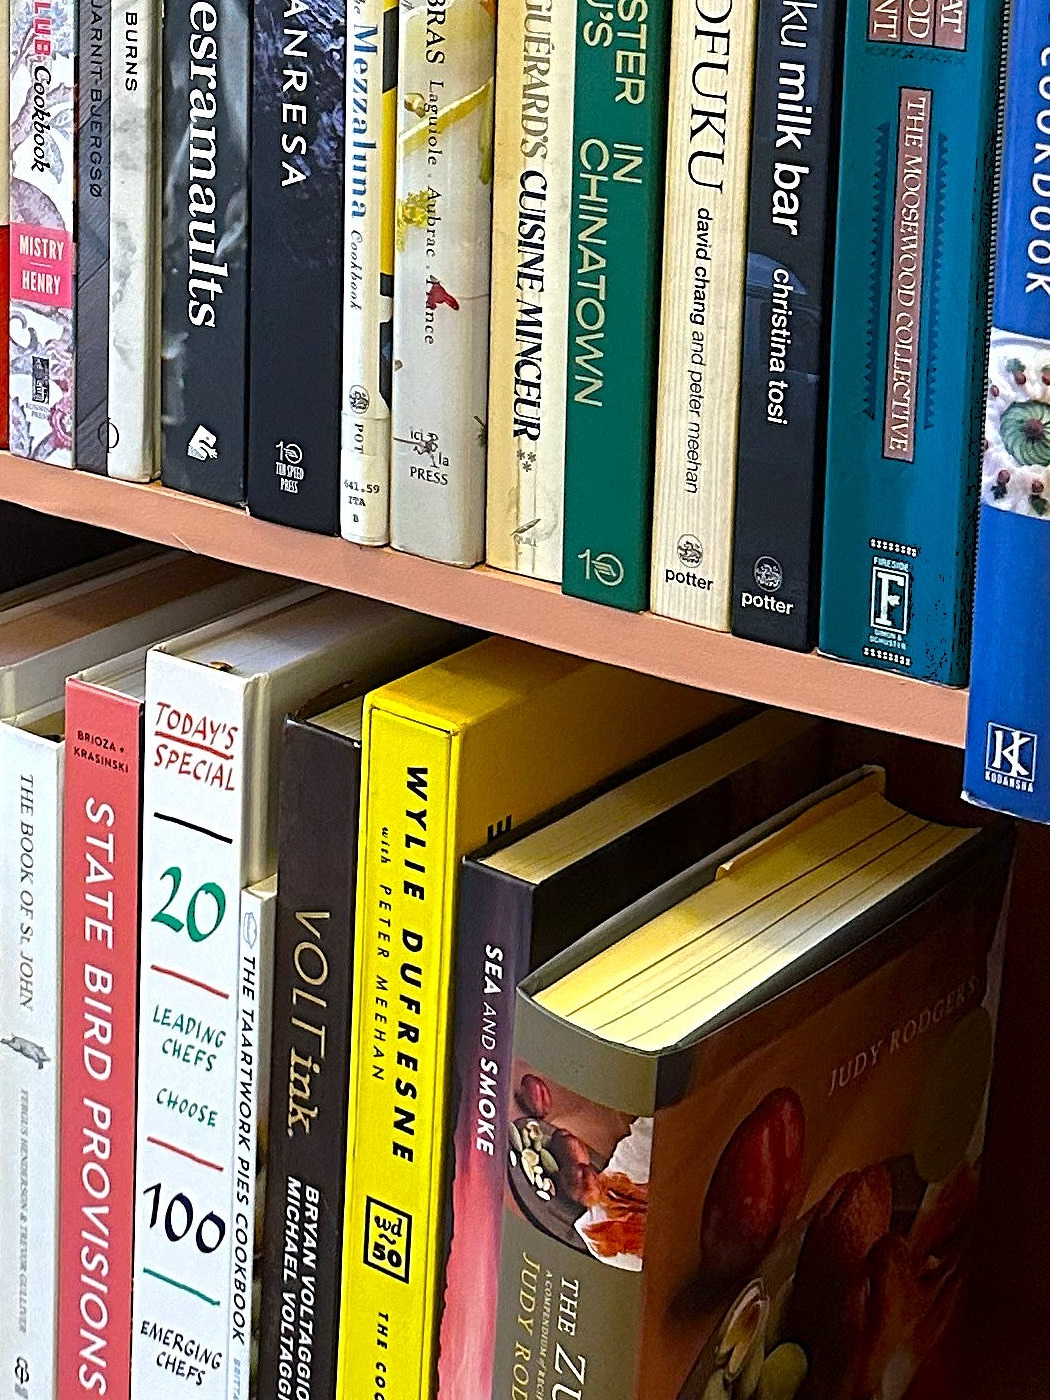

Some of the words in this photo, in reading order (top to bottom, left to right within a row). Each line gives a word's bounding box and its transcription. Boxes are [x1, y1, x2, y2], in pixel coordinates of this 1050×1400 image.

[31, 66, 52, 172] Cookbook
[774, 63, 812, 148] milk
[612, 143, 642, 184] IN
[771, 164, 809, 236] bar
[19, 234, 64, 261] MISTRY
[697, 208, 712, 260] david
[22, 269, 61, 296] HENRY
[574, 138, 609, 407] CHINATOWN
[689, 265, 711, 326] chang
[693, 331, 706, 363] and
[768, 268, 789, 375] christina
[685, 369, 704, 413] peter
[766, 379, 787, 426] tosi
[684, 418, 700, 494] meehan
[665, 567, 713, 592] potter
[741, 592, 794, 616] potter
[156, 701, 240, 750] TODAY'S
[153, 744, 236, 791] SPECIAL
[401, 766, 429, 901] WYLIE
[84, 796, 115, 948] STATE
[151, 866, 226, 942] 20
[483, 944, 504, 994] SEA
[82, 964, 113, 1081] BIRD
[153, 1004, 227, 1048] LEADING
[391, 928, 424, 1162] DUFRESNE
[481, 1001, 498, 1050] AND
[161, 1039, 216, 1072] CHEFS
[238, 1008, 255, 1152] TAARTWORK
[156, 1088, 218, 1128] CHOOSE
[476, 1059, 498, 1155] SMOKE
[236, 1160, 250, 1205] PIES
[78, 1097, 109, 1396] PROVISIONS
[142, 1182, 226, 1255] 100
[232, 1211, 250, 1345] COOKBOOK
